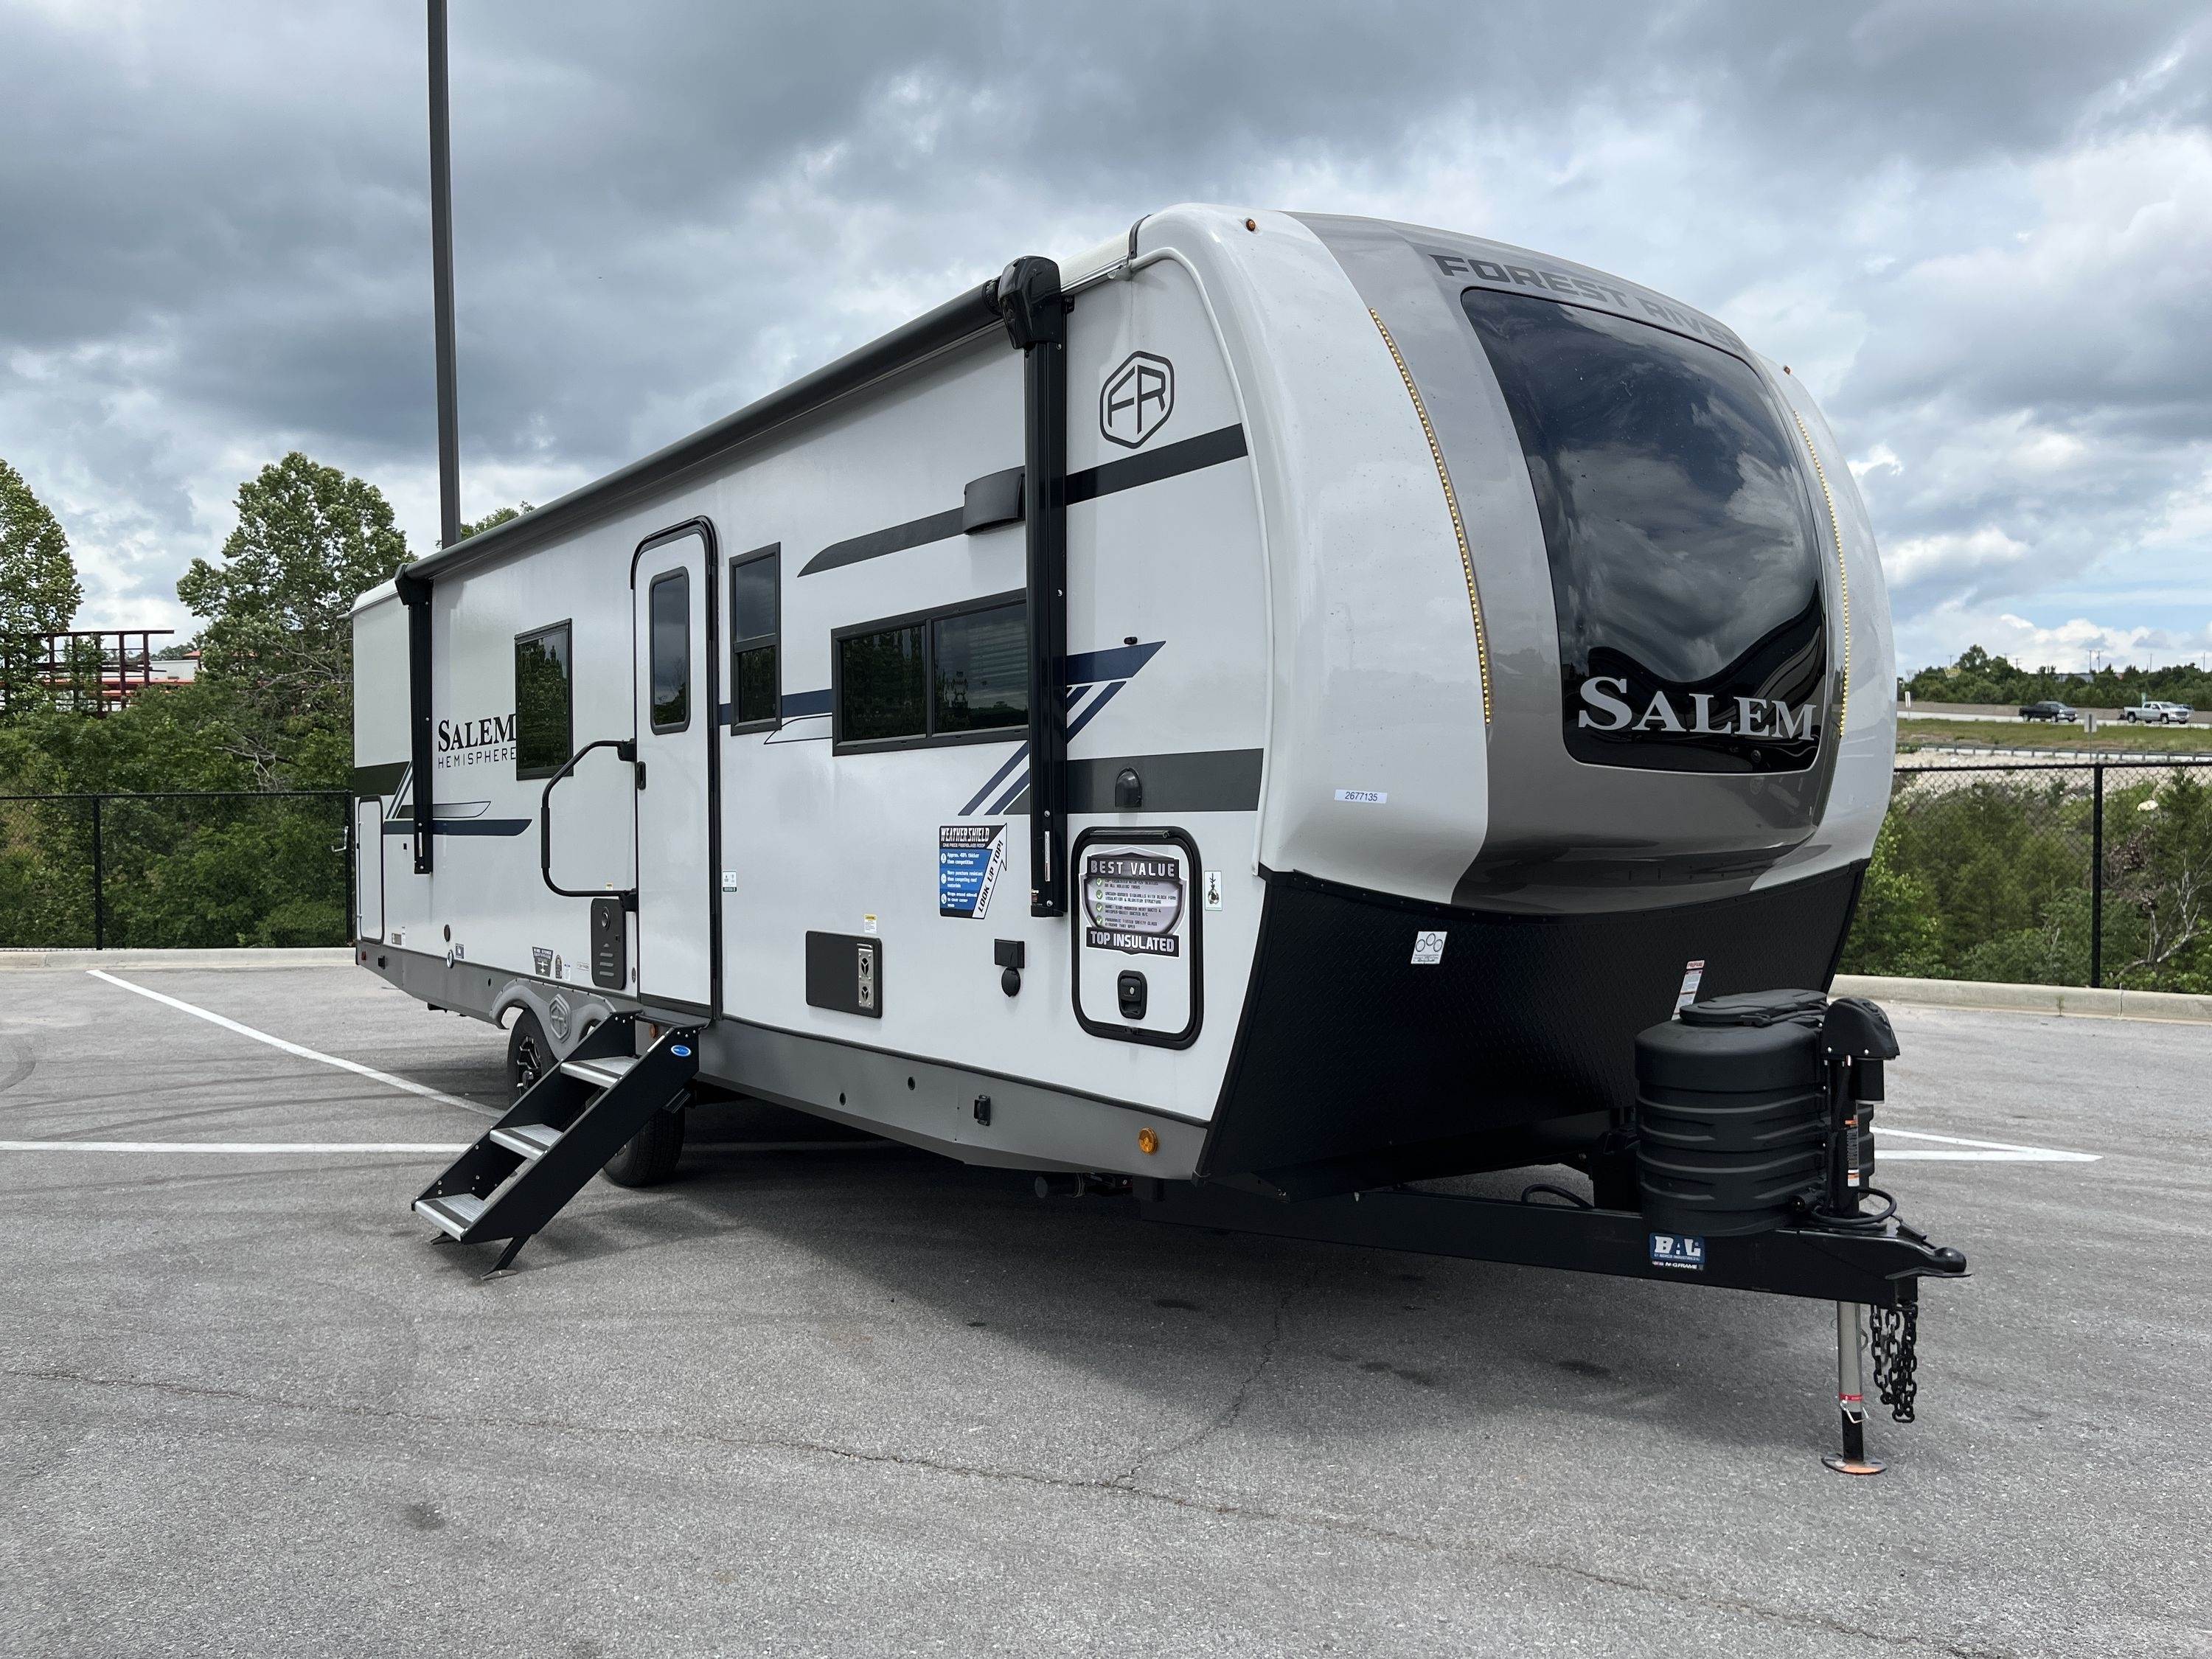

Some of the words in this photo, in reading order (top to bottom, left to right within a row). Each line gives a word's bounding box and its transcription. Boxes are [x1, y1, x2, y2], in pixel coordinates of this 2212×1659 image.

[1427, 254, 1628, 308] FOREST
[1635, 296, 1754, 360] RIVER
[1578, 676, 1817, 742] SALEM
[438, 713, 516, 752] SALEM
[438, 746, 516, 769] HEMISPHERE
[1345, 791, 1378, 801] 2677135
[978, 886, 990, 913] LOOK
[987, 866, 995, 883] UP
[992, 839, 1004, 864] TOP!
[1091, 860, 1123, 874] BEST
[1130, 862, 1175, 877] VALUE
[1091, 931, 1110, 945] TOP
[1113, 933, 1175, 953] INSULATED
